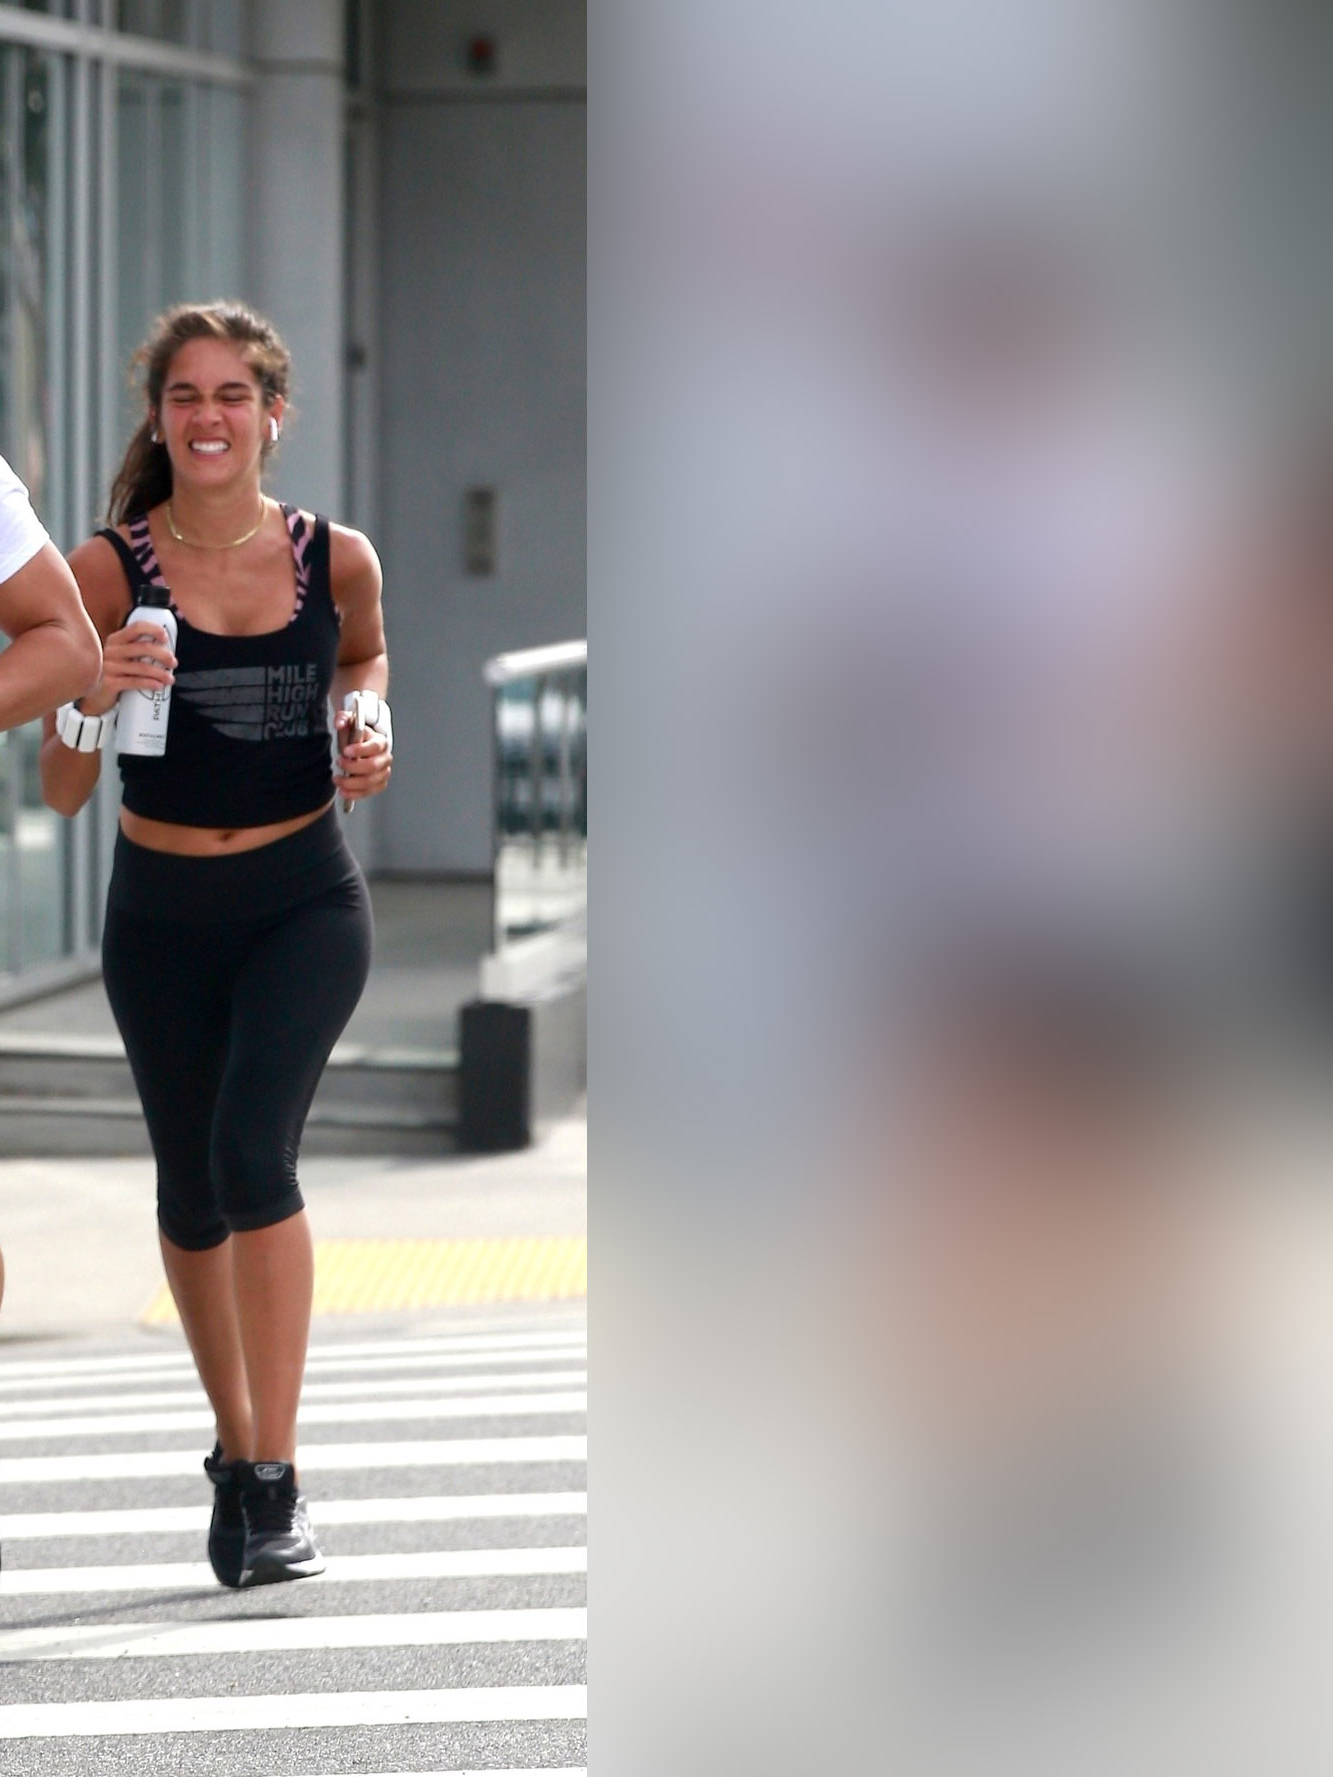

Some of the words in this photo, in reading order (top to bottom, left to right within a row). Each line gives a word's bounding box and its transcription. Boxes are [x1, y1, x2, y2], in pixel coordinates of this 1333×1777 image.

[268, 664, 317, 684] MILE
[268, 683, 319, 704] HIGH
[267, 703, 309, 721] RUN
